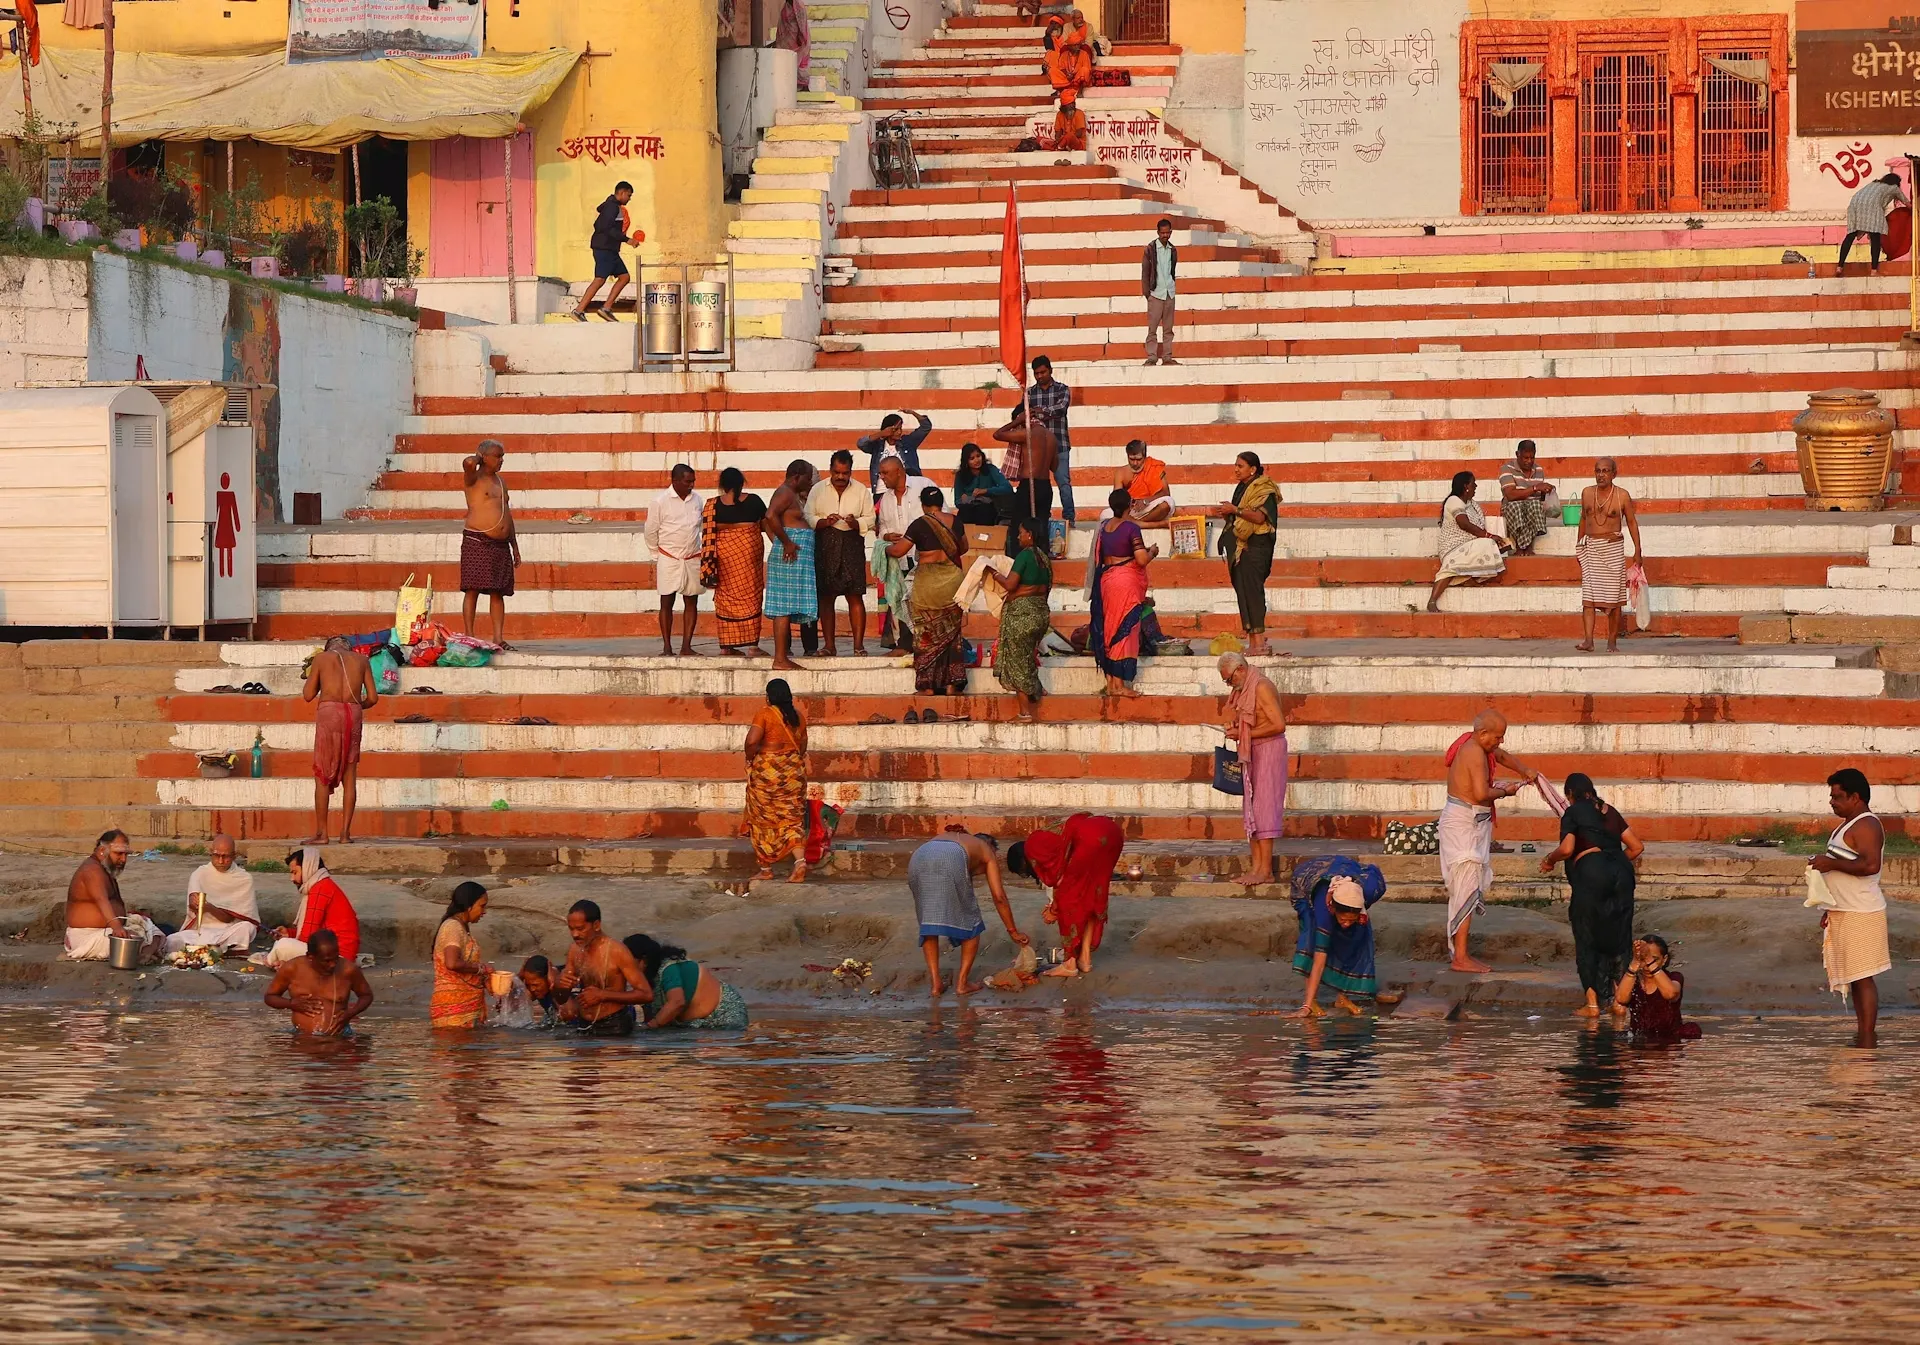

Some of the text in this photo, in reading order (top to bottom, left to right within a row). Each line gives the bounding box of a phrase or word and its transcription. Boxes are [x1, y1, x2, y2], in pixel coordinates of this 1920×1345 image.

[1345, 27, 1391, 69] विष्णु
[1297, 64, 1338, 92] श्रीमती
[556, 129, 665, 166] ॐ सूर्याय नमः
[1096, 146, 1129, 162] आपका
[1130, 139, 1157, 166] हार्दिक
[1146, 167, 1170, 188] करता
